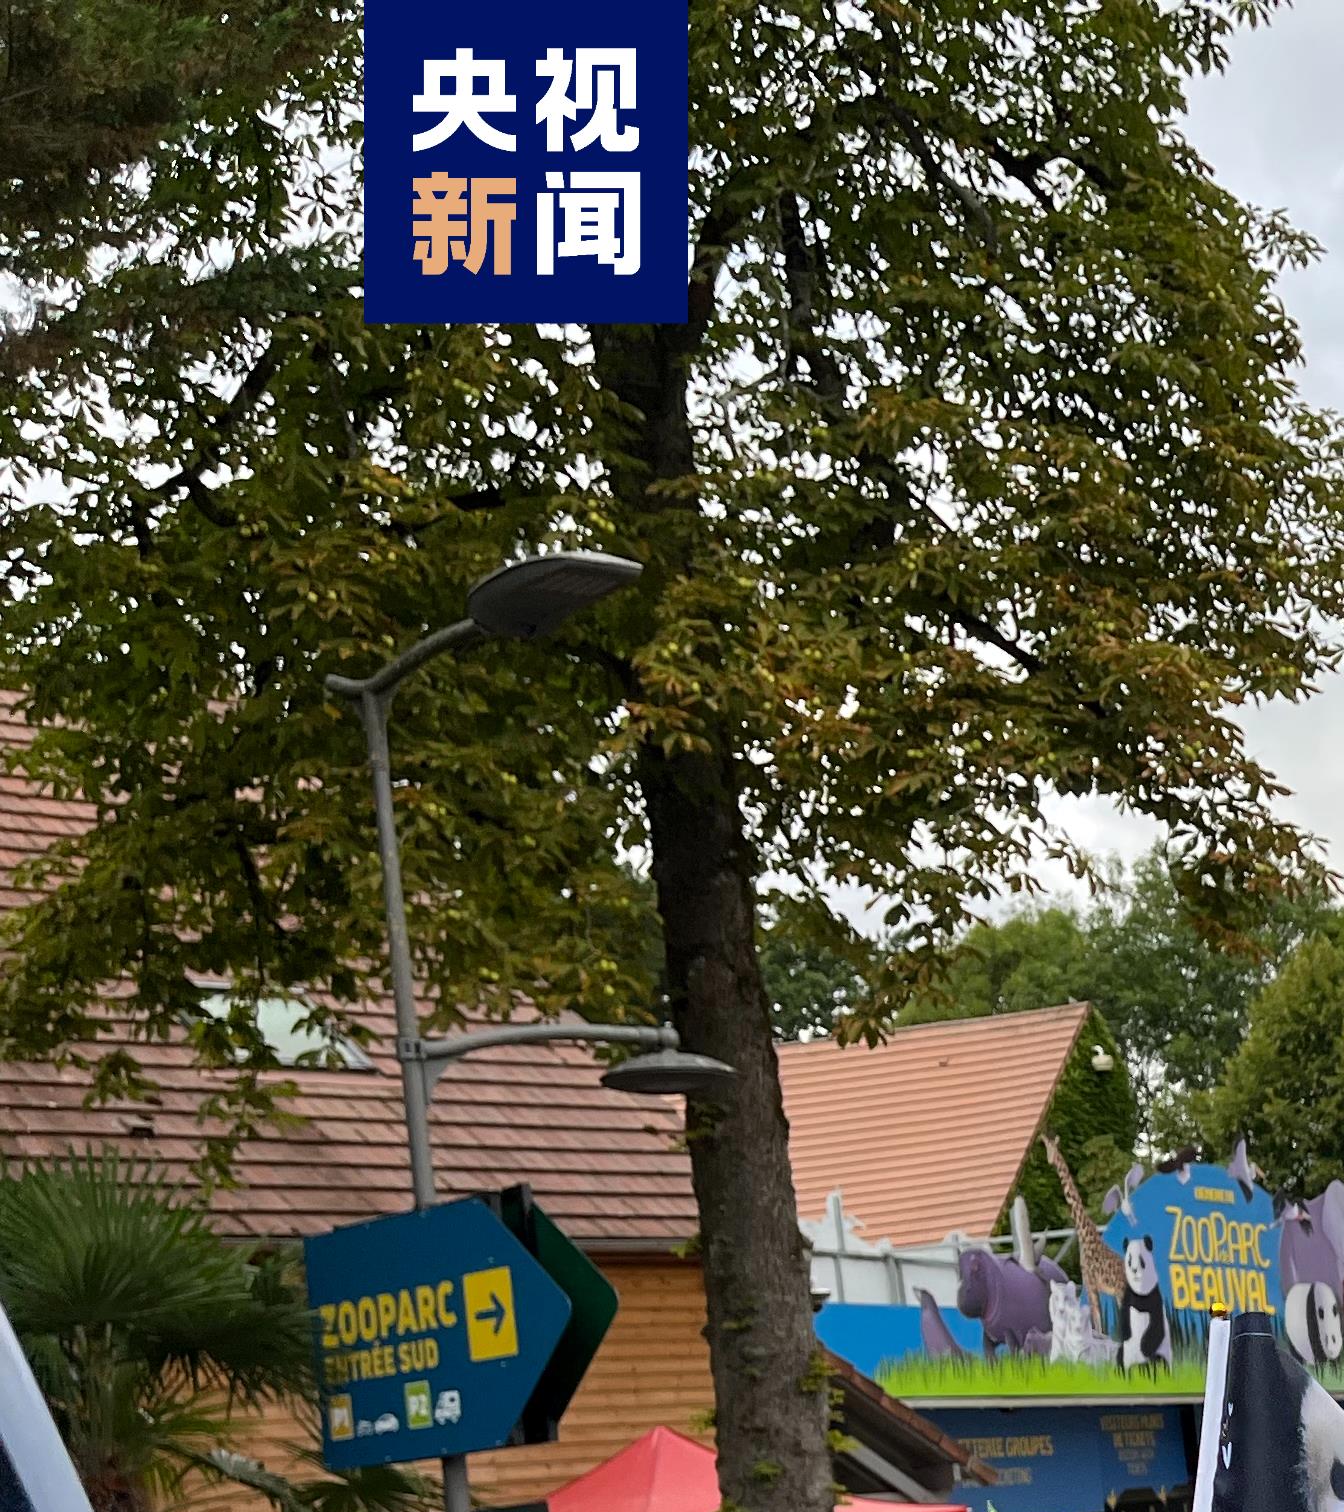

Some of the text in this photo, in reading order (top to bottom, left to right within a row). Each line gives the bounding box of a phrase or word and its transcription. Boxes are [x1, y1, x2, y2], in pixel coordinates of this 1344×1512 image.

[1165, 1206, 1271, 1268] ZOOPARC
[320, 1280, 457, 1348] ZOOPARC
[1170, 1263, 1276, 1316] BEAUVAL
[399, 1338, 439, 1374] SUD
